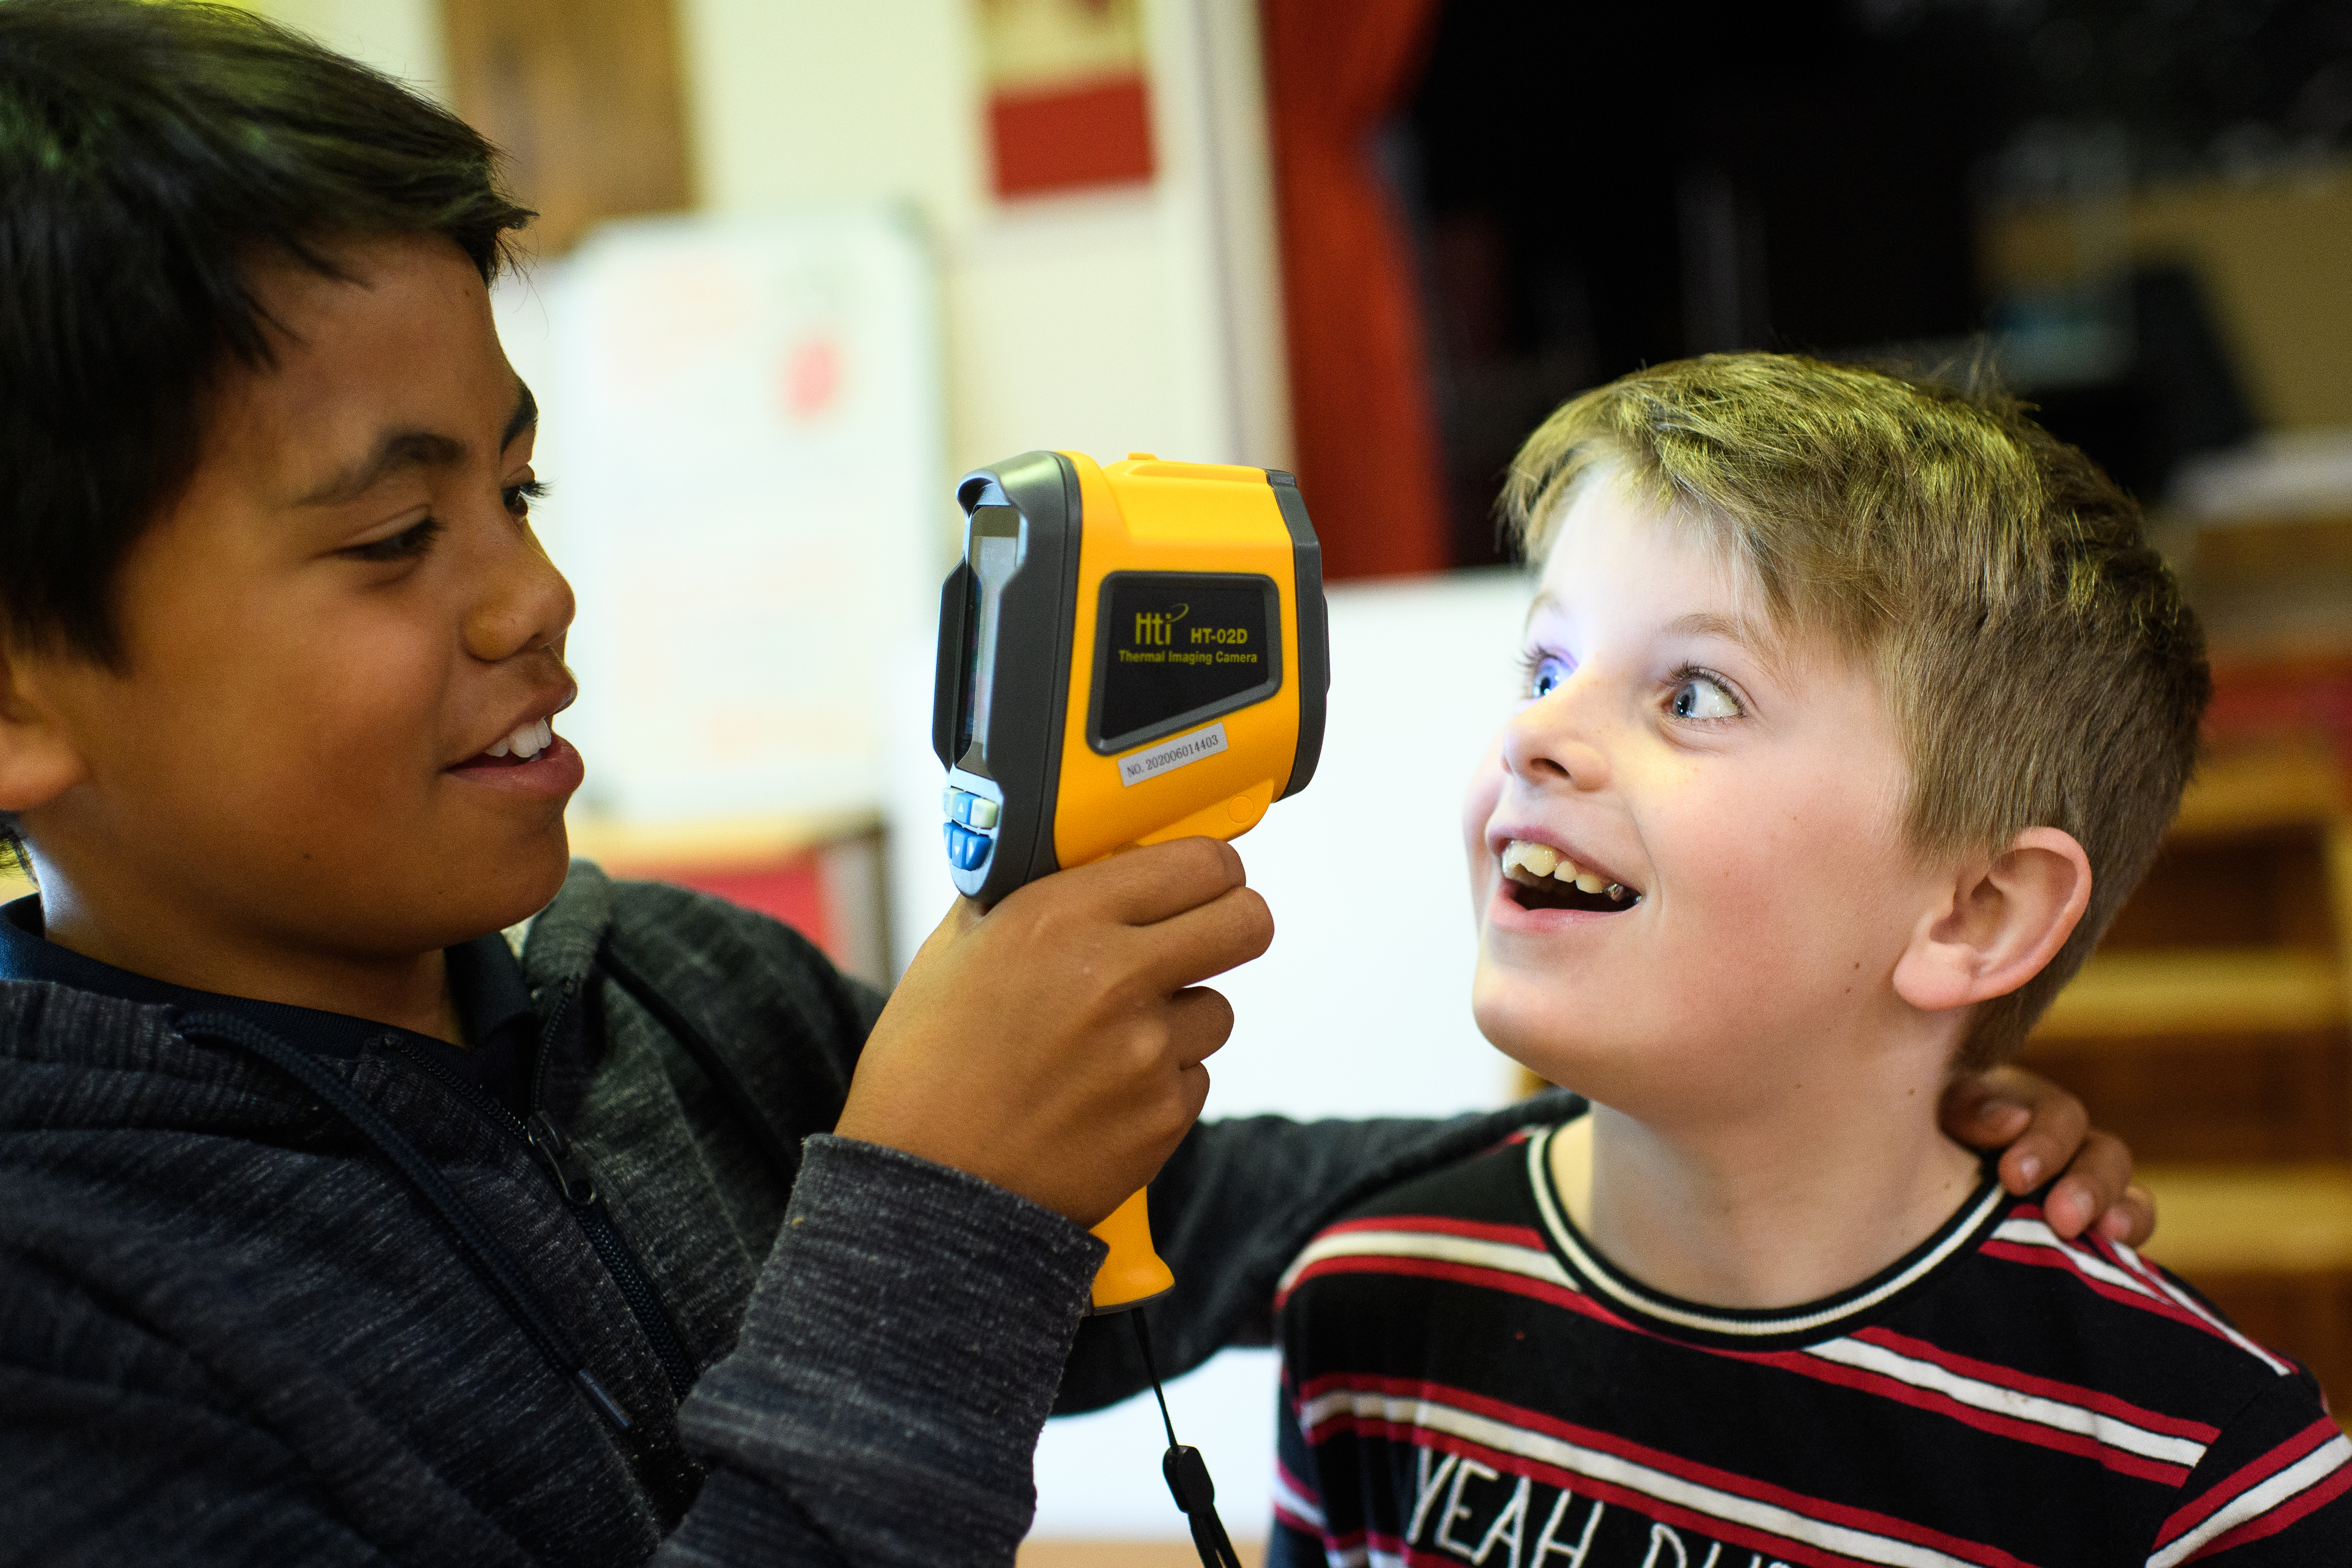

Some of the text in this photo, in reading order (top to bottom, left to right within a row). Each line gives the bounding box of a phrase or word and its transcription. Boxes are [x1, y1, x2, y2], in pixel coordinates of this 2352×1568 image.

[1135, 612, 1248, 645] Hti HT-02D
[1118, 649, 1258, 665] Thermal Imaging Camera
[1406, 1445, 1605, 1568] YEAH
